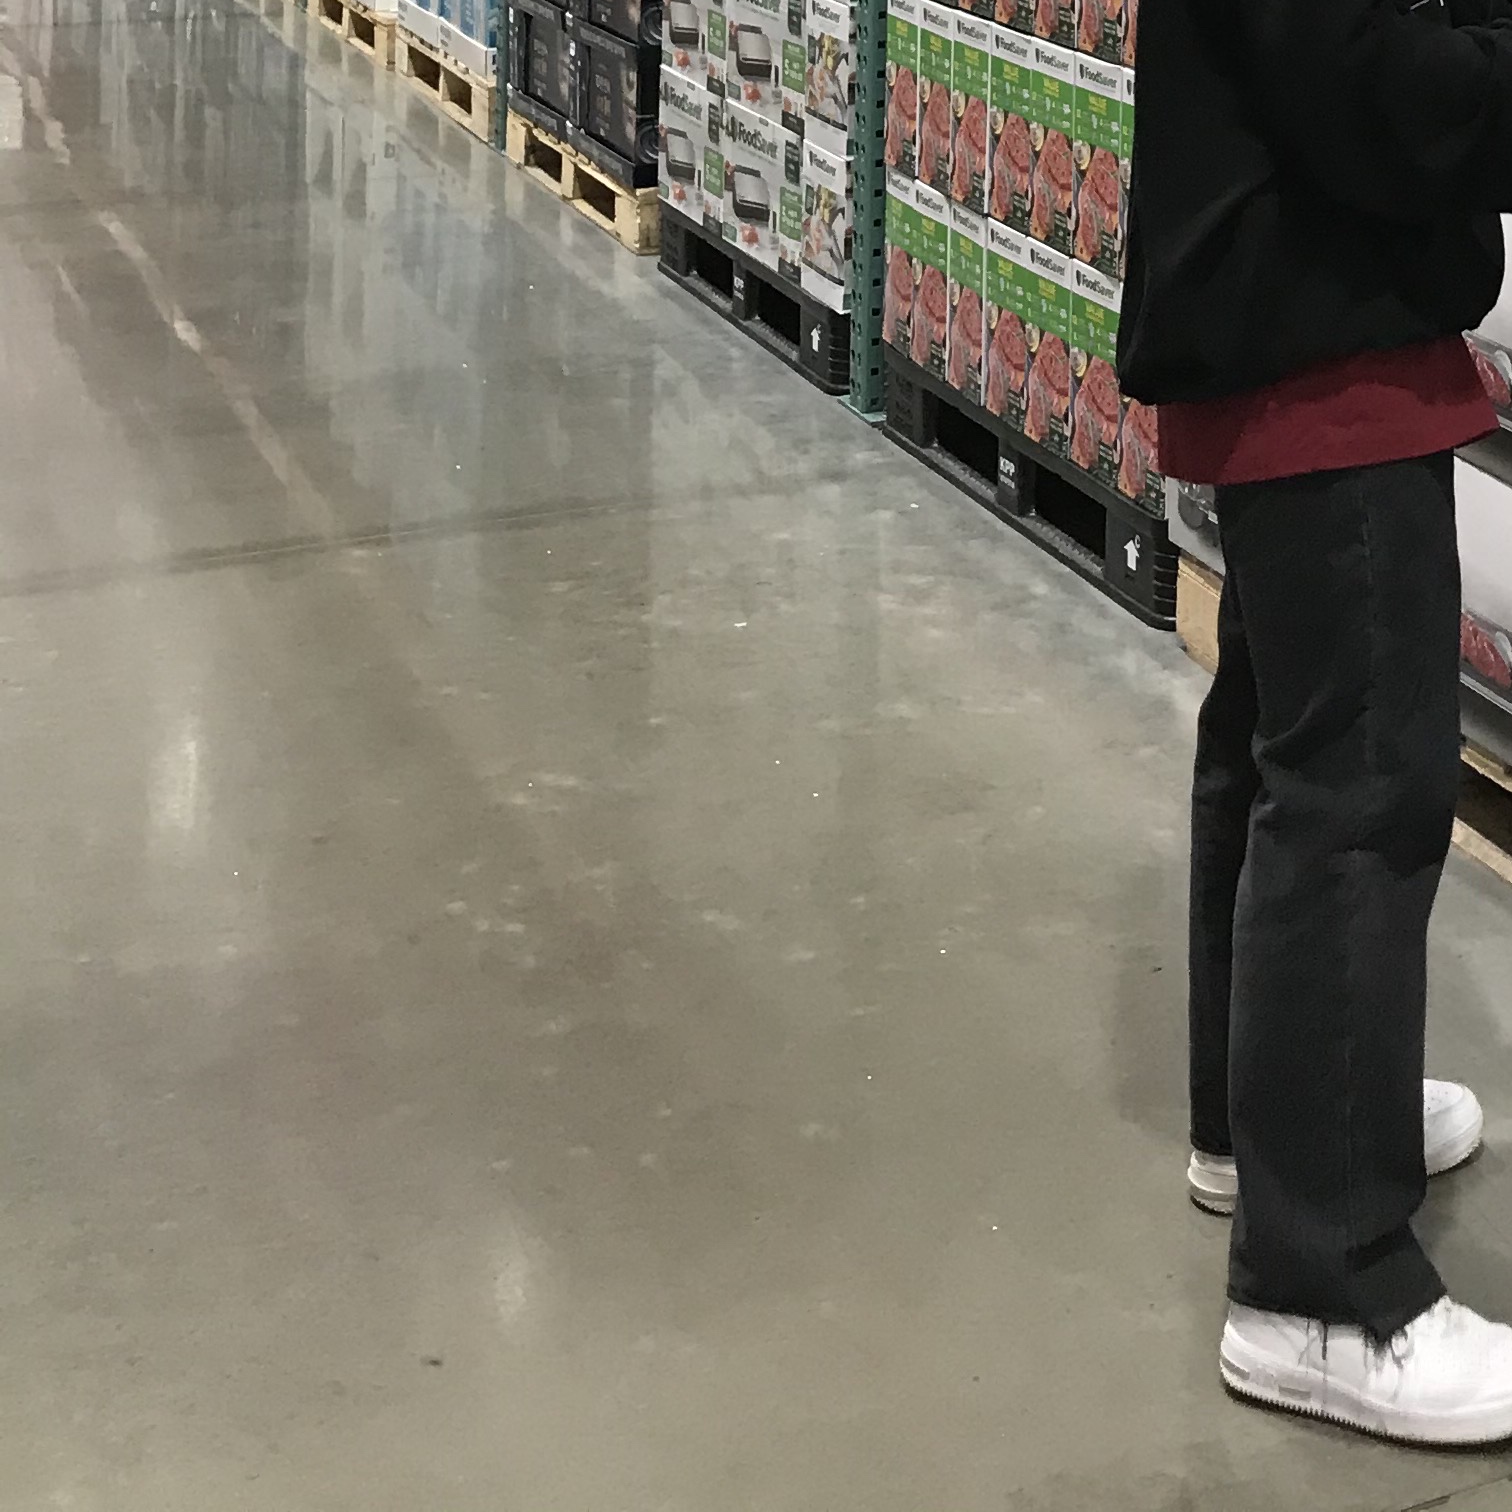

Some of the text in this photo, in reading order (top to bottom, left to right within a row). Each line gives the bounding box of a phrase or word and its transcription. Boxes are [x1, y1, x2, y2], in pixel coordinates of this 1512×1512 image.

[962, 20, 988, 43] FoodSaver
[1000, 36, 1028, 58] FoodSaver
[1040, 48, 1069, 72] FoodSaver
[1084, 65, 1118, 88] FoodSaver
[739, 124, 778, 158] FoodSaver
[995, 229, 1022, 254] FoodSaver
[1035, 249, 1066, 276] FoodSaver
[1081, 271, 1116, 299] FoodSaver
